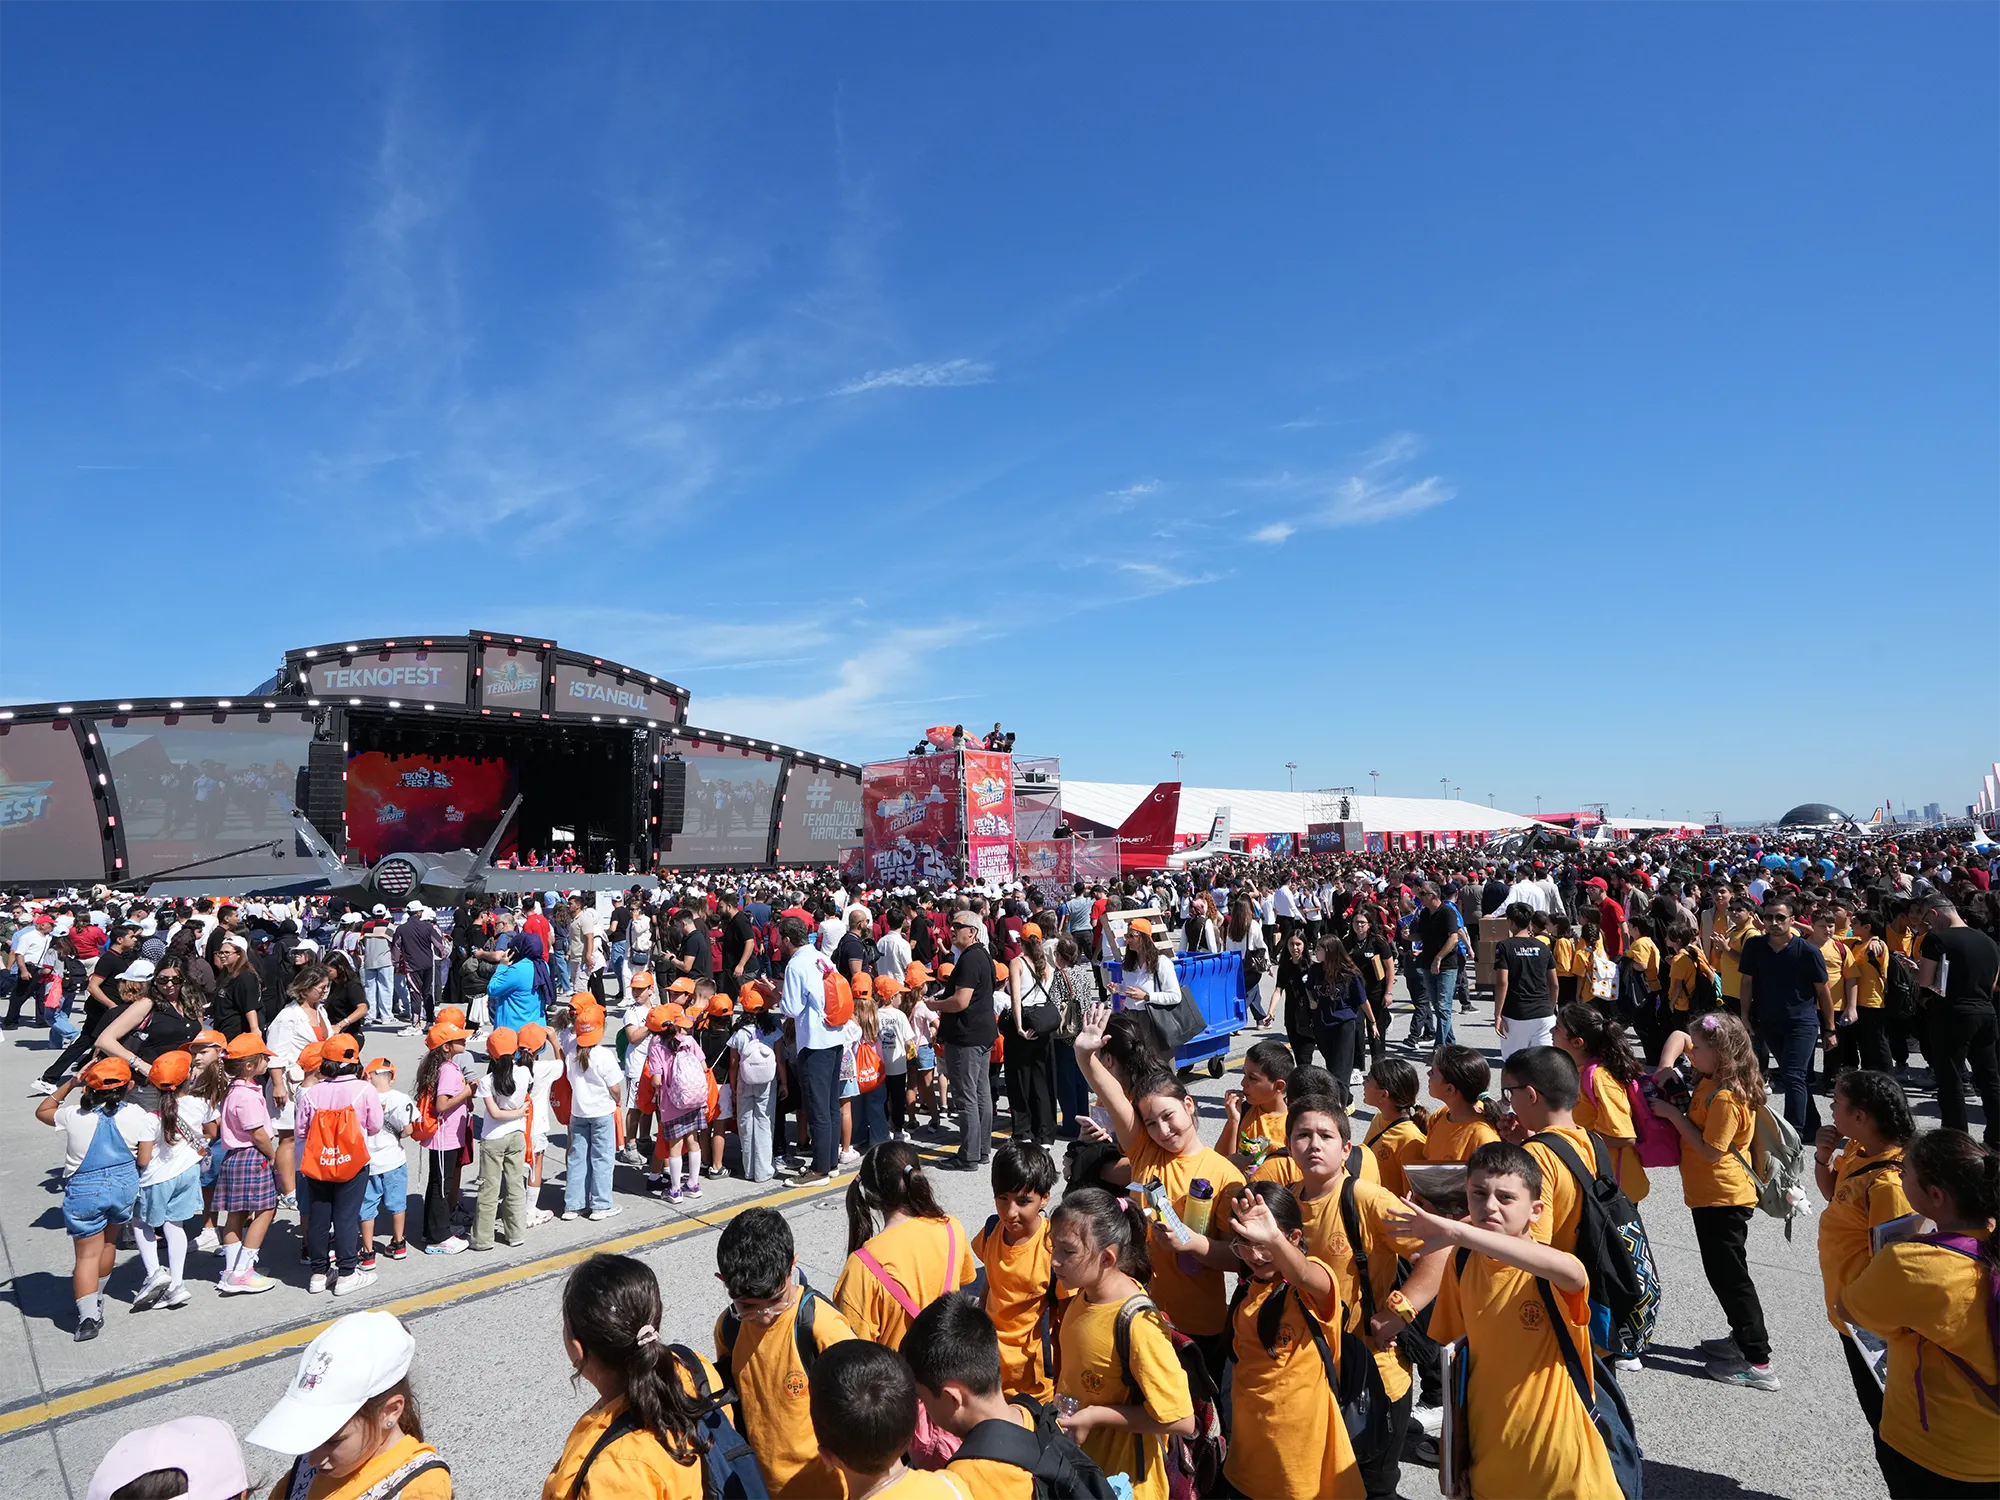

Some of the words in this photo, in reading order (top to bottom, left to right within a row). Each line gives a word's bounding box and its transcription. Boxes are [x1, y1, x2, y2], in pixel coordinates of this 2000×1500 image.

[324, 668, 442, 688] TEKNOFEST
[486, 678, 538, 695] TEKNOFEST
[889, 806, 927, 831] TEKNOFEST
[872, 844, 916, 869] TEKNO
